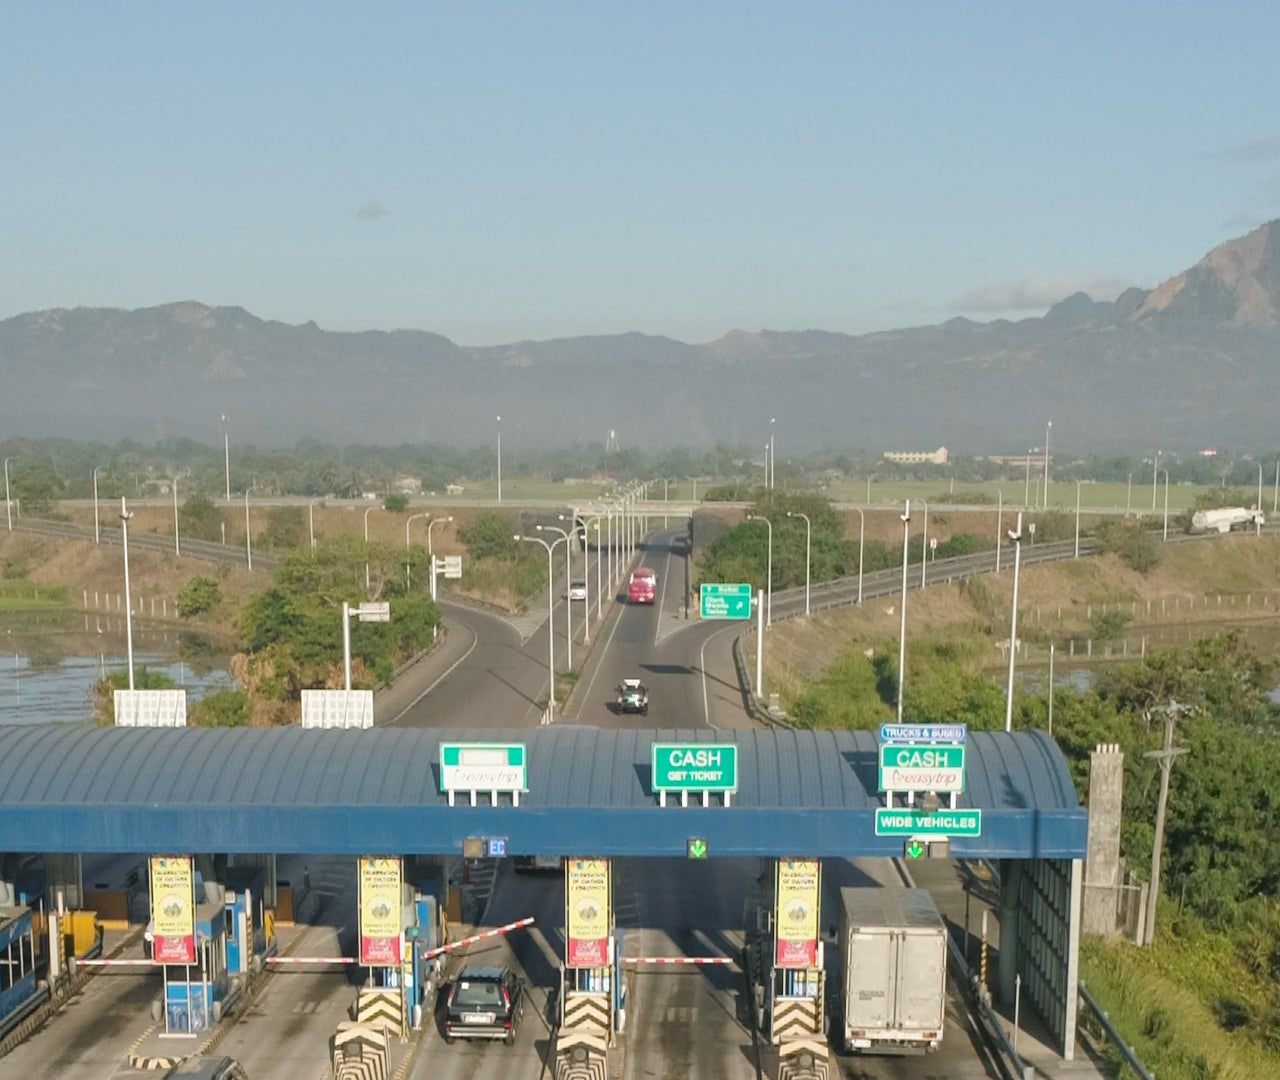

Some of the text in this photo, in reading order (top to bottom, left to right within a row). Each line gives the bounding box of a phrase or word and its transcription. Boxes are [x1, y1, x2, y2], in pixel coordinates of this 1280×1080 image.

[885, 727, 921, 738] TRUCKS
[923, 727, 930, 738] &
[669, 750, 721, 767] CASH
[896, 750, 949, 768] CASH
[667, 770, 723, 781] GET TICKET
[880, 816, 976, 829] WIDE VEHICLES
